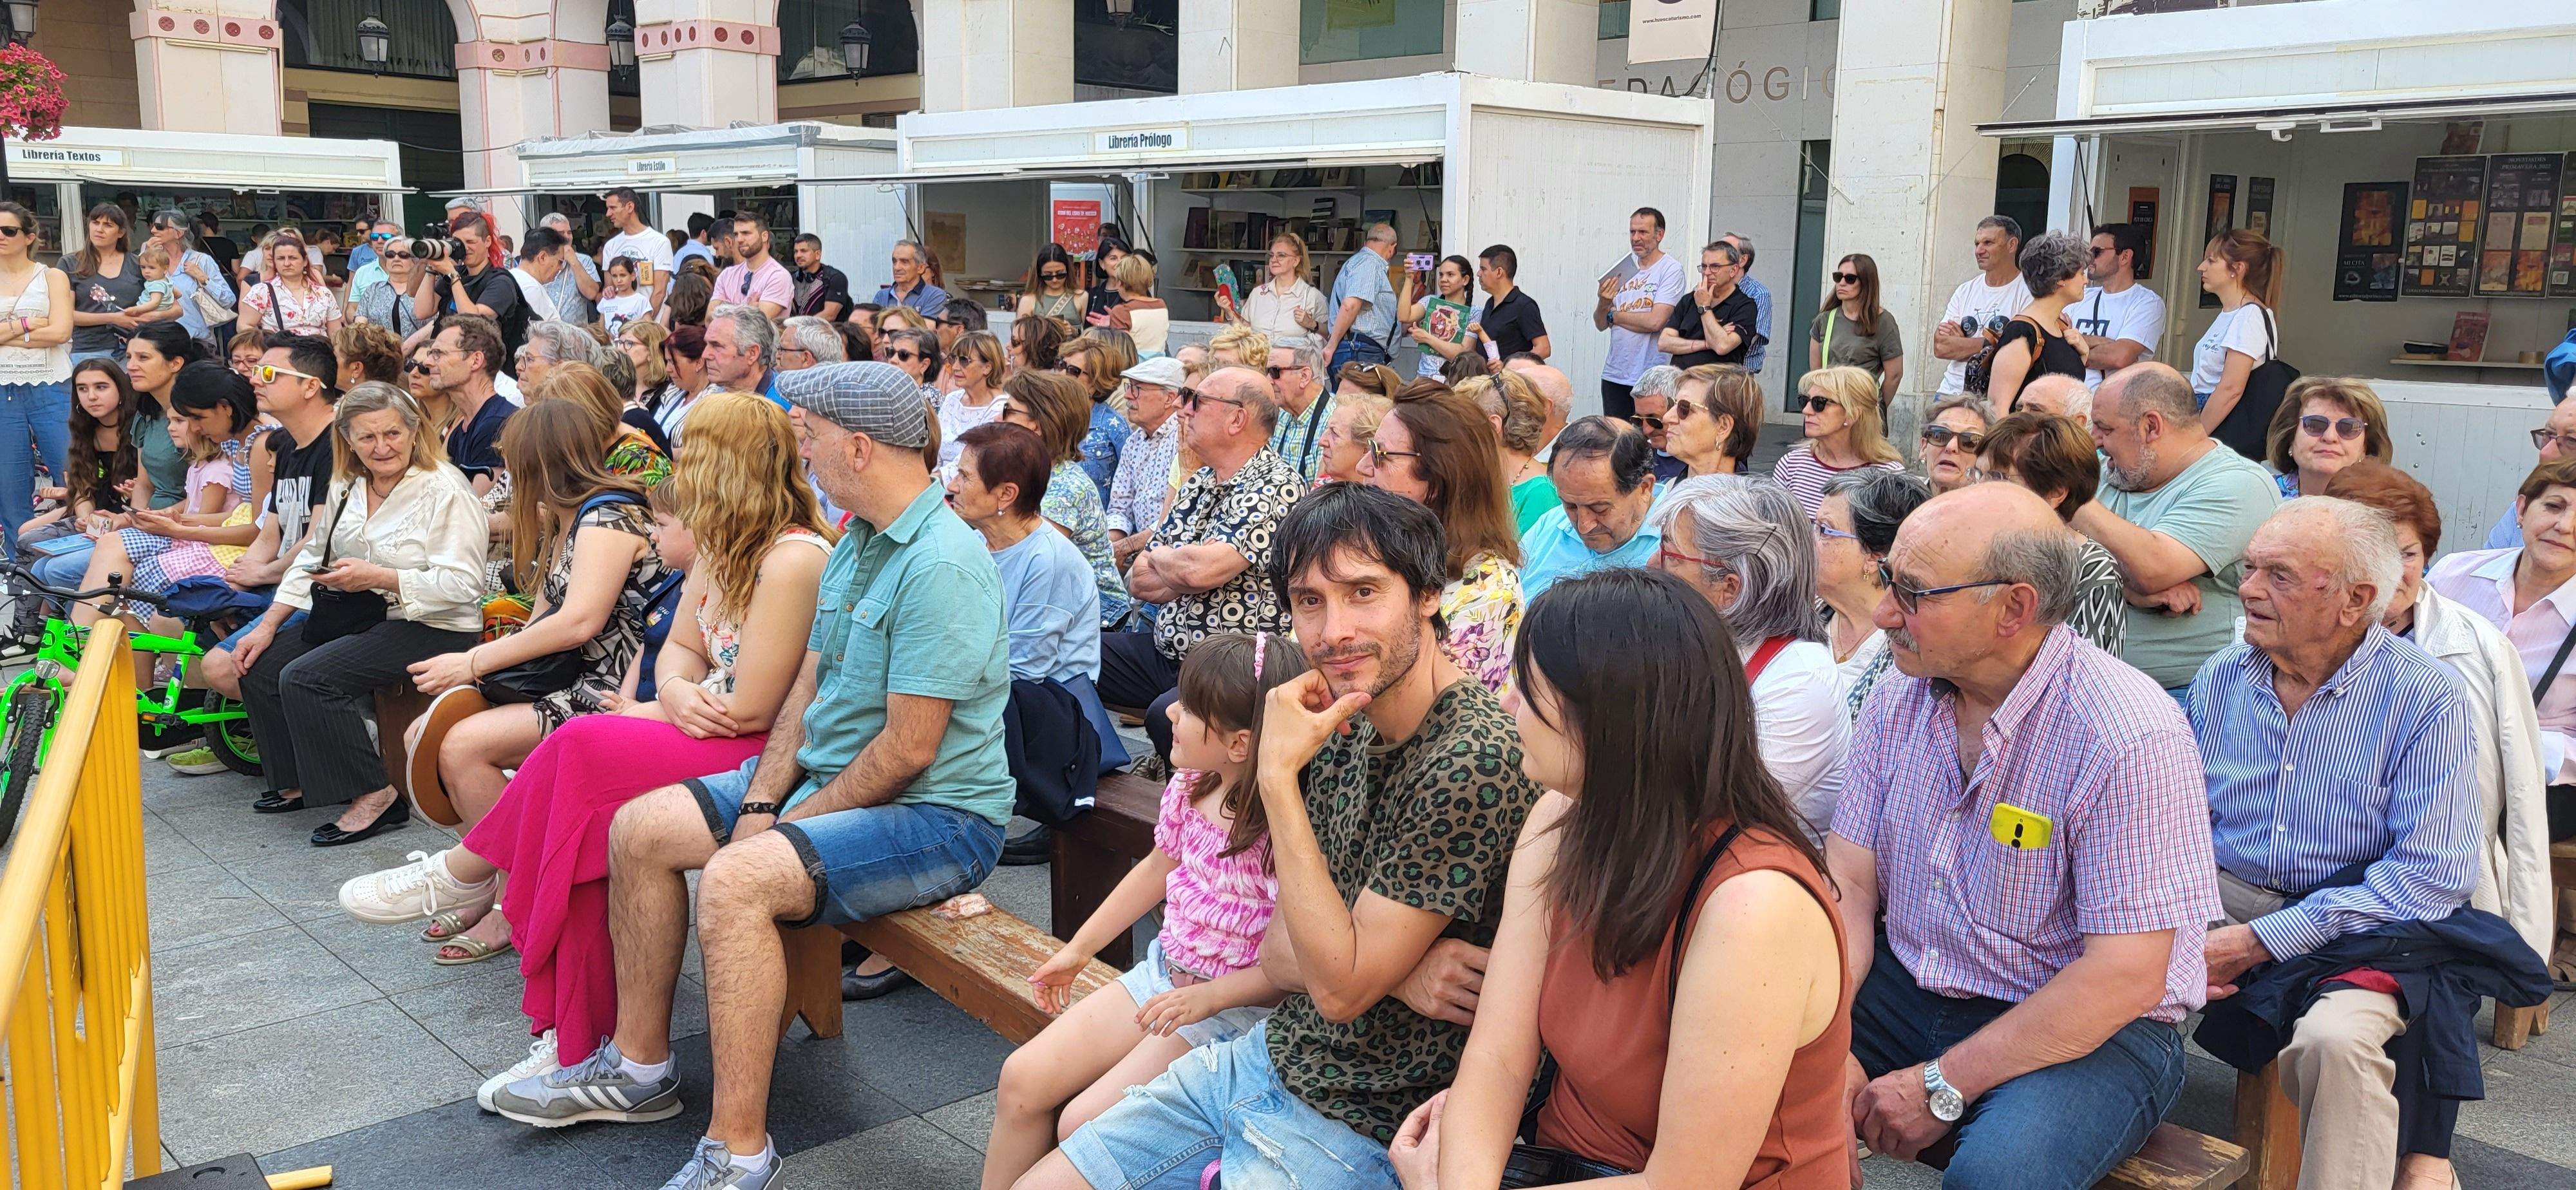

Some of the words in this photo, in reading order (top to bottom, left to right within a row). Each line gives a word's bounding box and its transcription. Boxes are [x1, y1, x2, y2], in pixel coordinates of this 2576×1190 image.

[1108, 133, 1139, 149] Librería
[1140, 132, 1172, 148] Prólogo
[22, 149, 65, 160] Librería
[66, 151, 101, 162] Textos
[636, 161, 652, 171] Librería
[653, 160, 666, 171] Estilo
